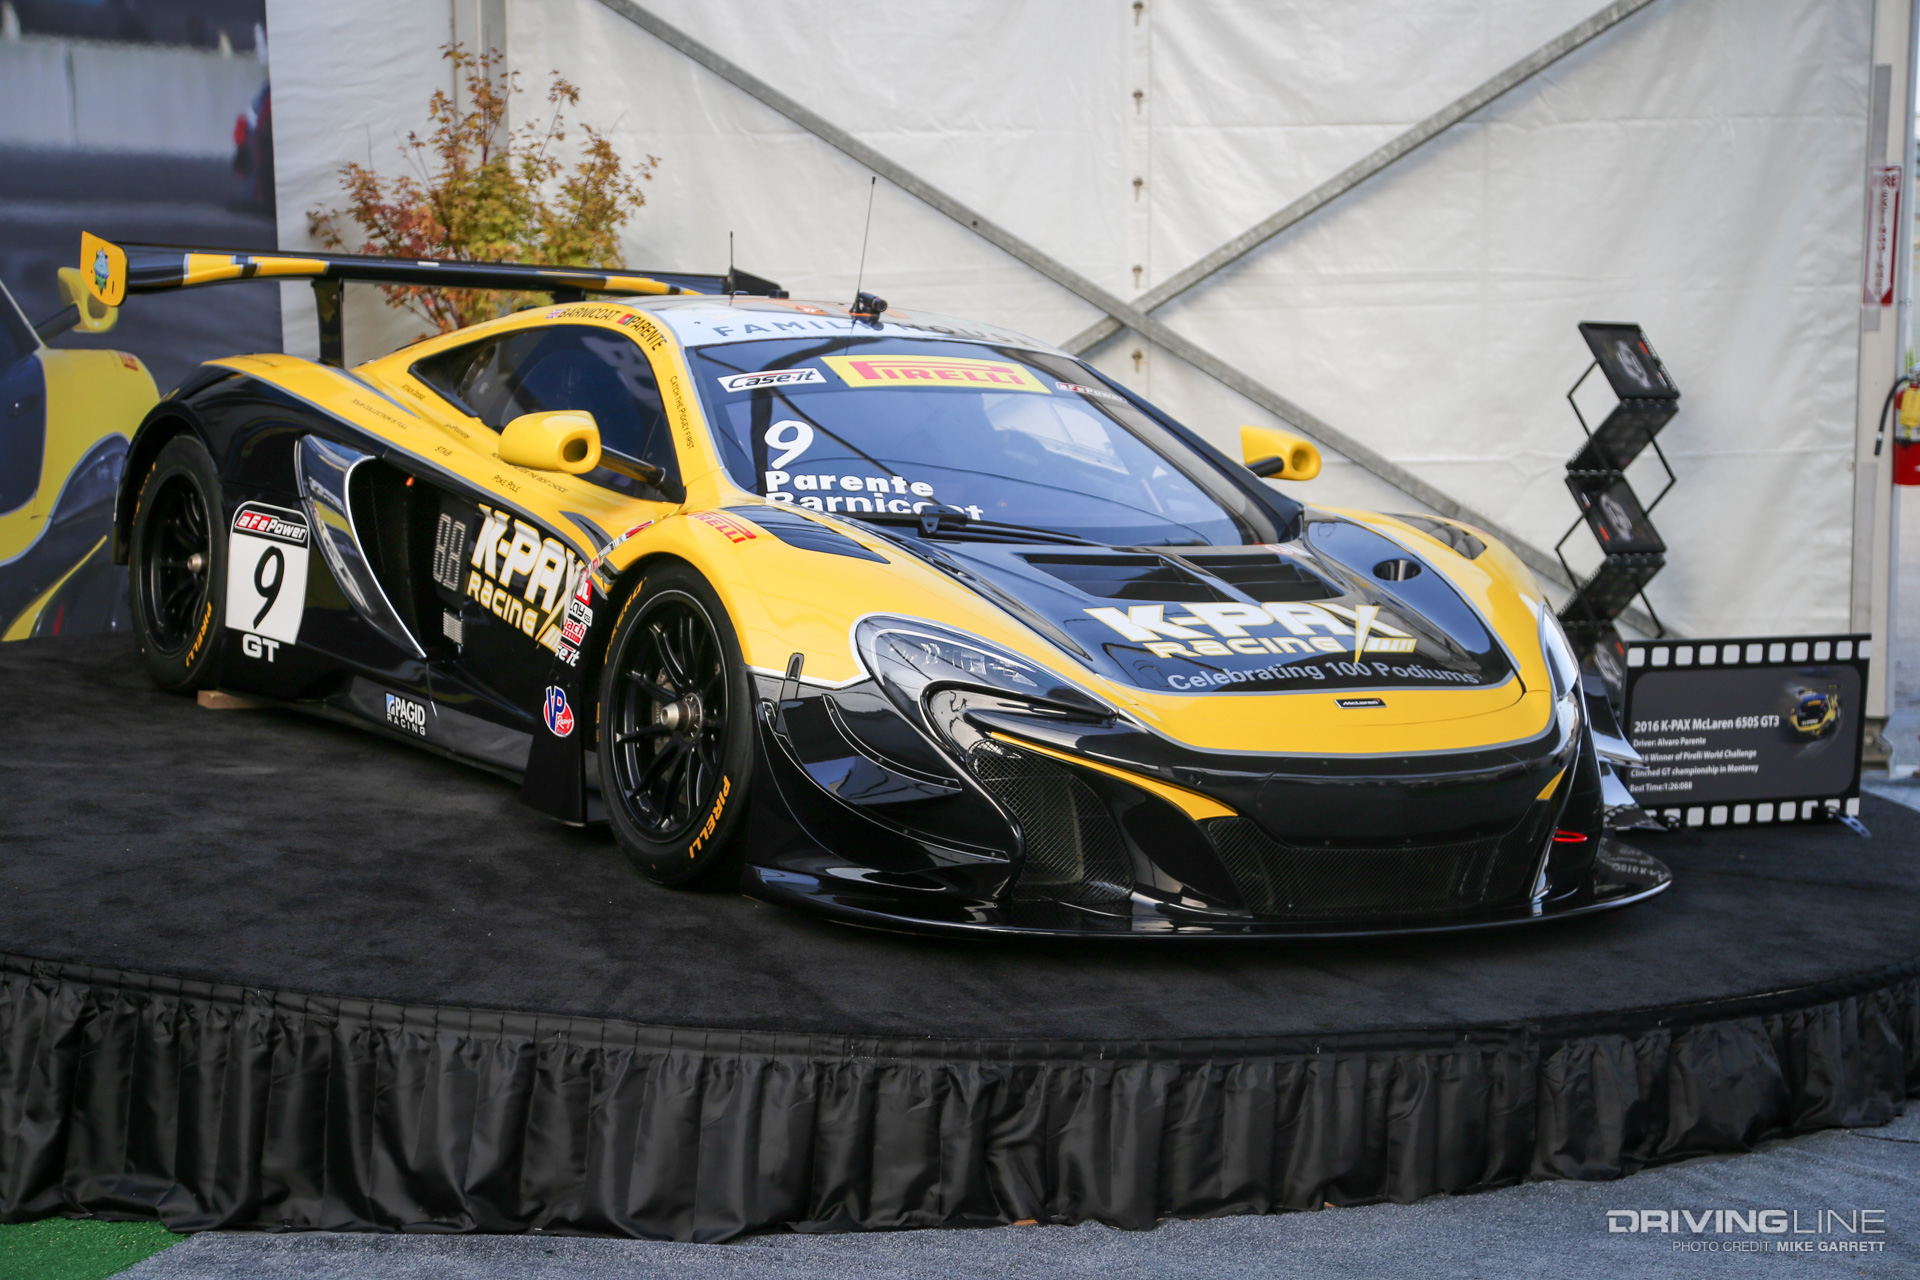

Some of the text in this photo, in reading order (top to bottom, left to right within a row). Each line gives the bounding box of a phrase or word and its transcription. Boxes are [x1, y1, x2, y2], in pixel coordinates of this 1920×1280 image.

[557, 307, 621, 320] BARNICOAT
[626, 314, 667, 351] PARENTE
[847, 360, 1025, 385] PIRELLI
[764, 419, 814, 470] 9
[765, 470, 934, 497] Parente
[254, 545, 285, 630] 9
[1083, 601, 1414, 645] K-PAX
[242, 633, 280, 663] GT
[1167, 661, 1480, 690] Celebrating 100 Podiums
[394, 697, 426, 726] PAGID
[546, 686, 566, 732] VP
[387, 713, 426, 736] RACING
[1634, 715, 1780, 733] 2016 K-PAX McLaren 650S GT3
[1633, 736, 1706, 748] Driver: Alvaro Parente
[1650, 752, 1675, 762] Winner
[1675, 751, 1683, 760] of
[1683, 750, 1703, 760] Pirelli
[1703, 750, 1723, 760] World
[1724, 748, 1757, 760] Challenge
[1630, 767, 1660, 778] Clinched
[1661, 766, 1672, 776] GT
[1672, 764, 1719, 777] championship
[1727, 763, 1759, 774] Monterey
[1629, 783, 1645, 793] Best
[689, 775, 731, 859] PIRELLI
